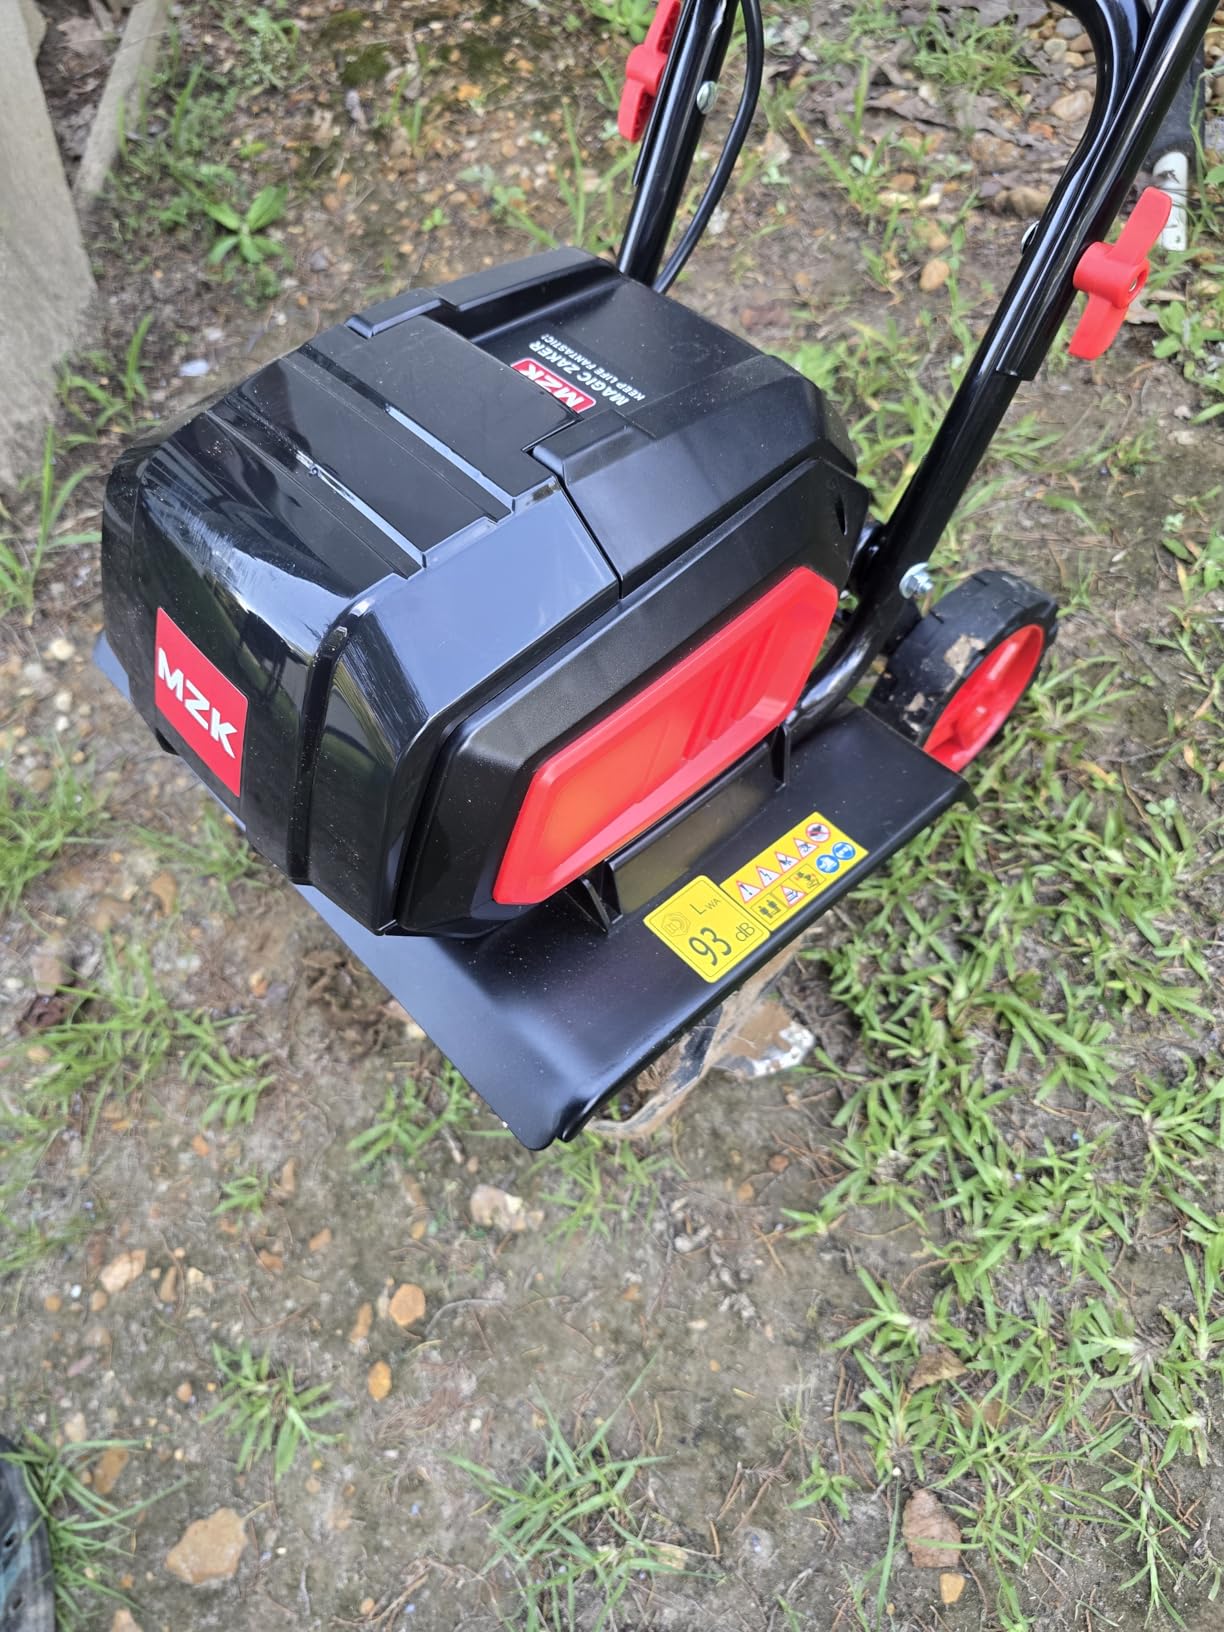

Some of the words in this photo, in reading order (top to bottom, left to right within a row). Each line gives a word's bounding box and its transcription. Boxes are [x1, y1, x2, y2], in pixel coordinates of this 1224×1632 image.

[528, 340, 581, 375] ZAKER
[540, 333, 597, 371] FANTASTIC!
[518, 363, 585, 408] MZK
[576, 370, 630, 406] MAGIC
[593, 368, 619, 384] LIFE
[616, 382, 646, 401] KEEP
[157, 647, 238, 760] MZK
[688, 927, 732, 966] 93
[735, 922, 755, 942] dB
